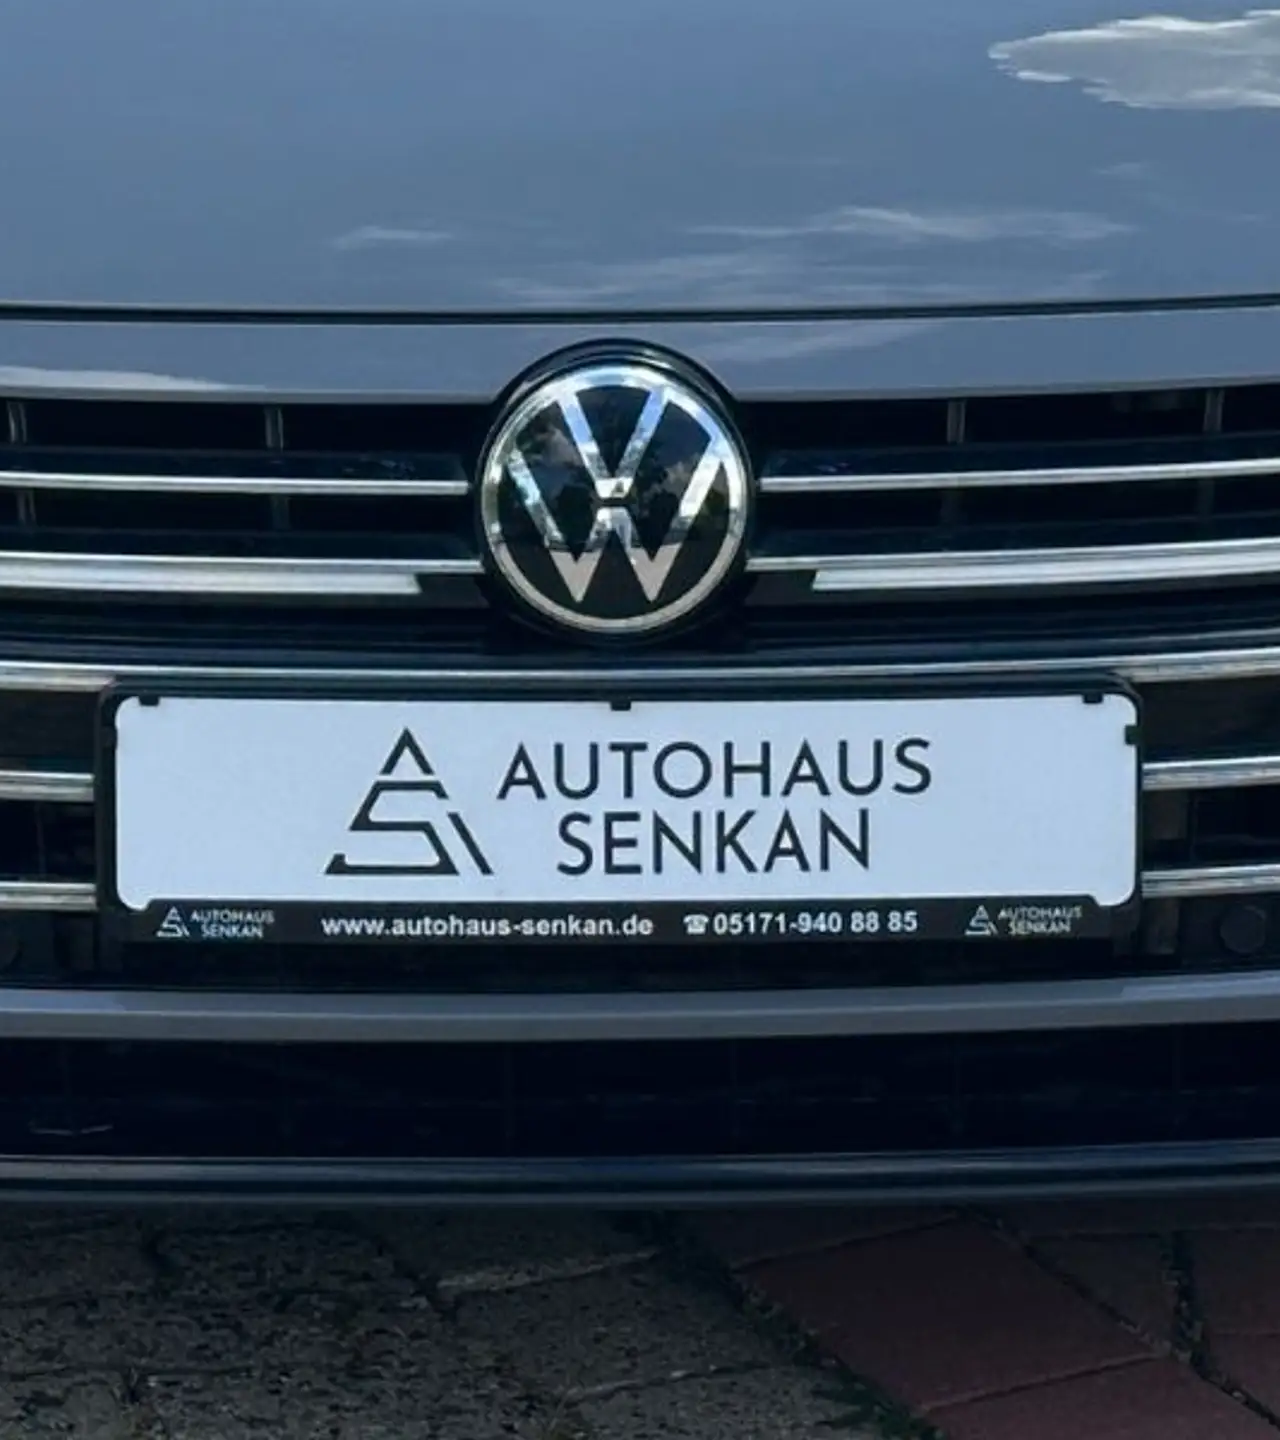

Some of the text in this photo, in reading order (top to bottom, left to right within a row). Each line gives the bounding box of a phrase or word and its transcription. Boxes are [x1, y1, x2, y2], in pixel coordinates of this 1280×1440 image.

[496, 738, 932, 800] AUTOHAUS
[556, 808, 870, 876] SENKAN
[190, 909, 275, 924] AUTOHAUS
[997, 905, 1083, 921] AUTOHAUS
[201, 923, 264, 938] SENKAN
[321, 911, 919, 937] www.autohaus-senkan.de 05171-940 88 85
[1007, 919, 1072, 936] SENKAN
